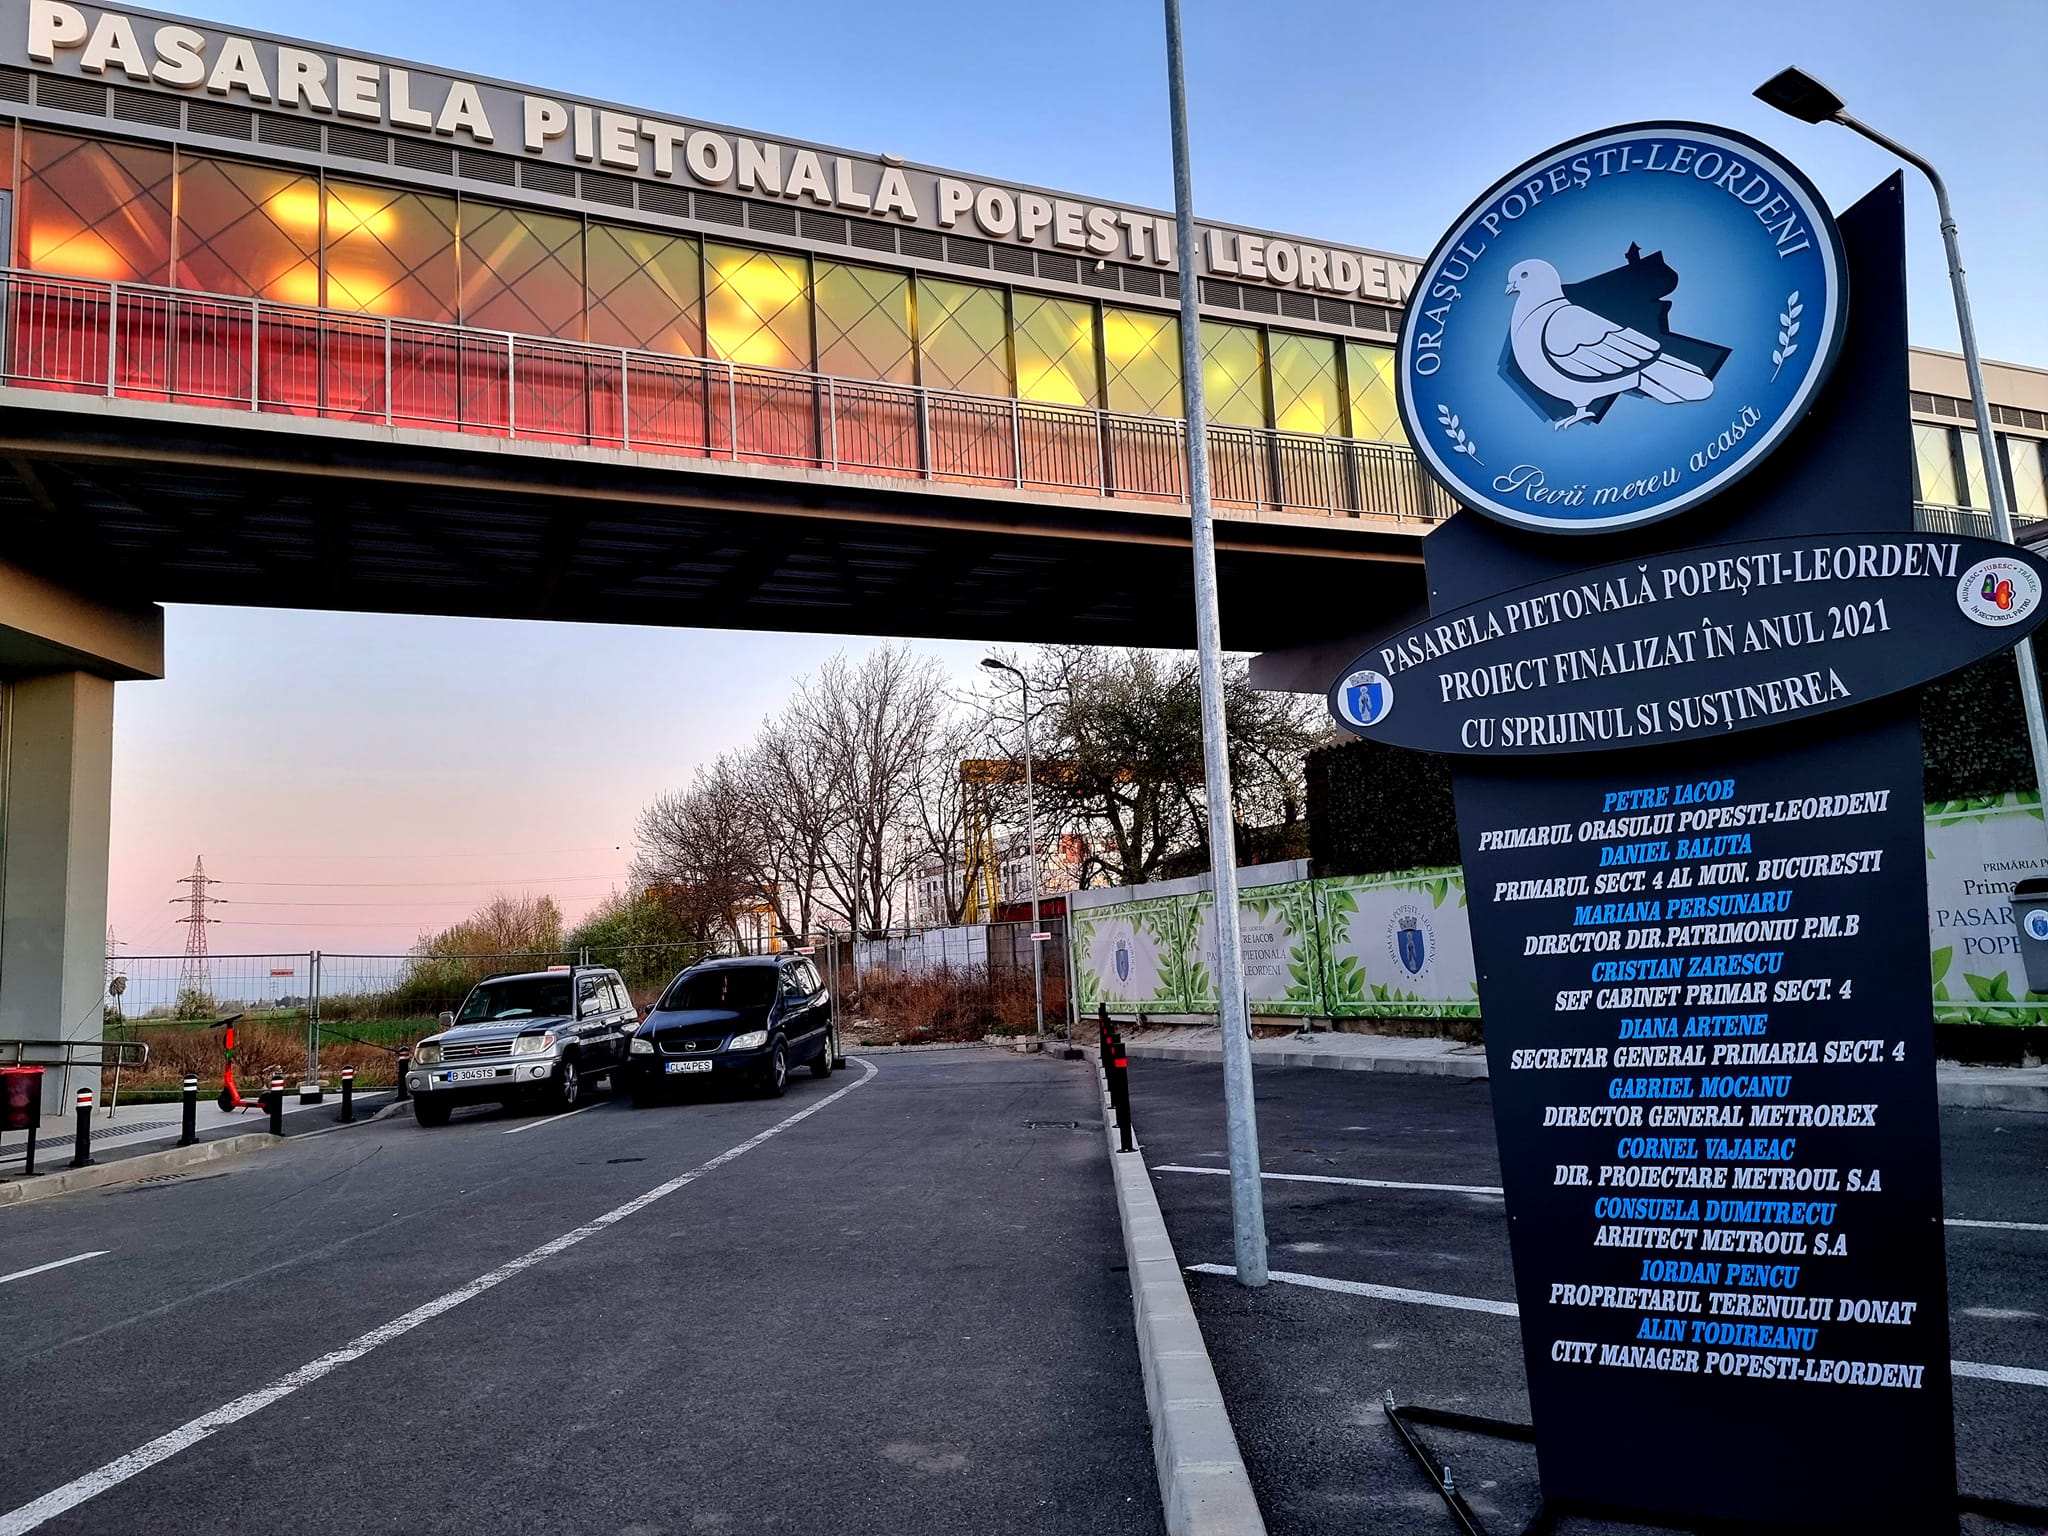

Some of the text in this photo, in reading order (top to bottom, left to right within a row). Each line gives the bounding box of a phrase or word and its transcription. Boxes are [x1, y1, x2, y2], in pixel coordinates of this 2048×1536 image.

[28, 0, 494, 143] PASARELA
[523, 95, 918, 222] PIETONALĂ
[1593, 467, 1681, 507] mereu
[1689, 406, 1761, 472] acasă
[1983, 563, 2013, 572] IUBESC
[1380, 610, 1505, 676] PASARELA
[1504, 564, 1657, 634] PIETONALĂ
[1978, 611, 2014, 621] SECTORUL
[2013, 598, 2031, 616] PATRU
[1439, 598, 1891, 703] PROIECT FINALIZAT ÎN ANUL 2021
[1461, 719, 1497, 748] CU
[1501, 707, 1633, 747] SPRIJINUL
[1636, 703, 1663, 735] SI
[1603, 779, 1735, 812] PETRE IACOB
[1478, 789, 1890, 851] PRIMARUL ORASULUI POPESTI-LEORDENI
[1599, 833, 1752, 867] DANIEL BALUTA
[1493, 850, 1883, 902] PRIMARUL SECT. 4 AL MUN. BUCURESTI
[1573, 890, 1793, 926] MARIANA PERSUNARU
[1523, 914, 1860, 955] DIRECTOR DIR.PATRIMONIU P.M.B
[1591, 952, 1784, 983] CRISTIAN ZARESCU
[1555, 979, 1852, 1011] SEF CABINET PRIMAR SECT. 4
[1618, 1014, 1768, 1039] DIANA ARTENE
[1510, 1040, 1905, 1070] SECRETAR GENERAL PRIMARIA SECT. 4
[1608, 1075, 1792, 1100] GABRIEL MOCANU
[1542, 1104, 1878, 1128] DIRECTOR GENERAL METROREX
[1617, 1137, 1796, 1162] CORNEL VAJAEAC
[1553, 1165, 1882, 1192] DIR. PROIECTARE METROUL S.A
[1594, 1197, 1837, 1225] CONSUELA DUMITRECU
[1593, 1225, 1848, 1257] ARHITECT METROUL S.A
[1640, 1259, 1800, 1289] IORDAN PENCU
[1549, 1284, 1917, 1325] PROPRIETARUL TERENULUI DONAT
[1636, 1318, 1819, 1351] ALIN TODIREANU
[1551, 1341, 1925, 1389] CITY MANAGER POPESTI-LEORDENI
